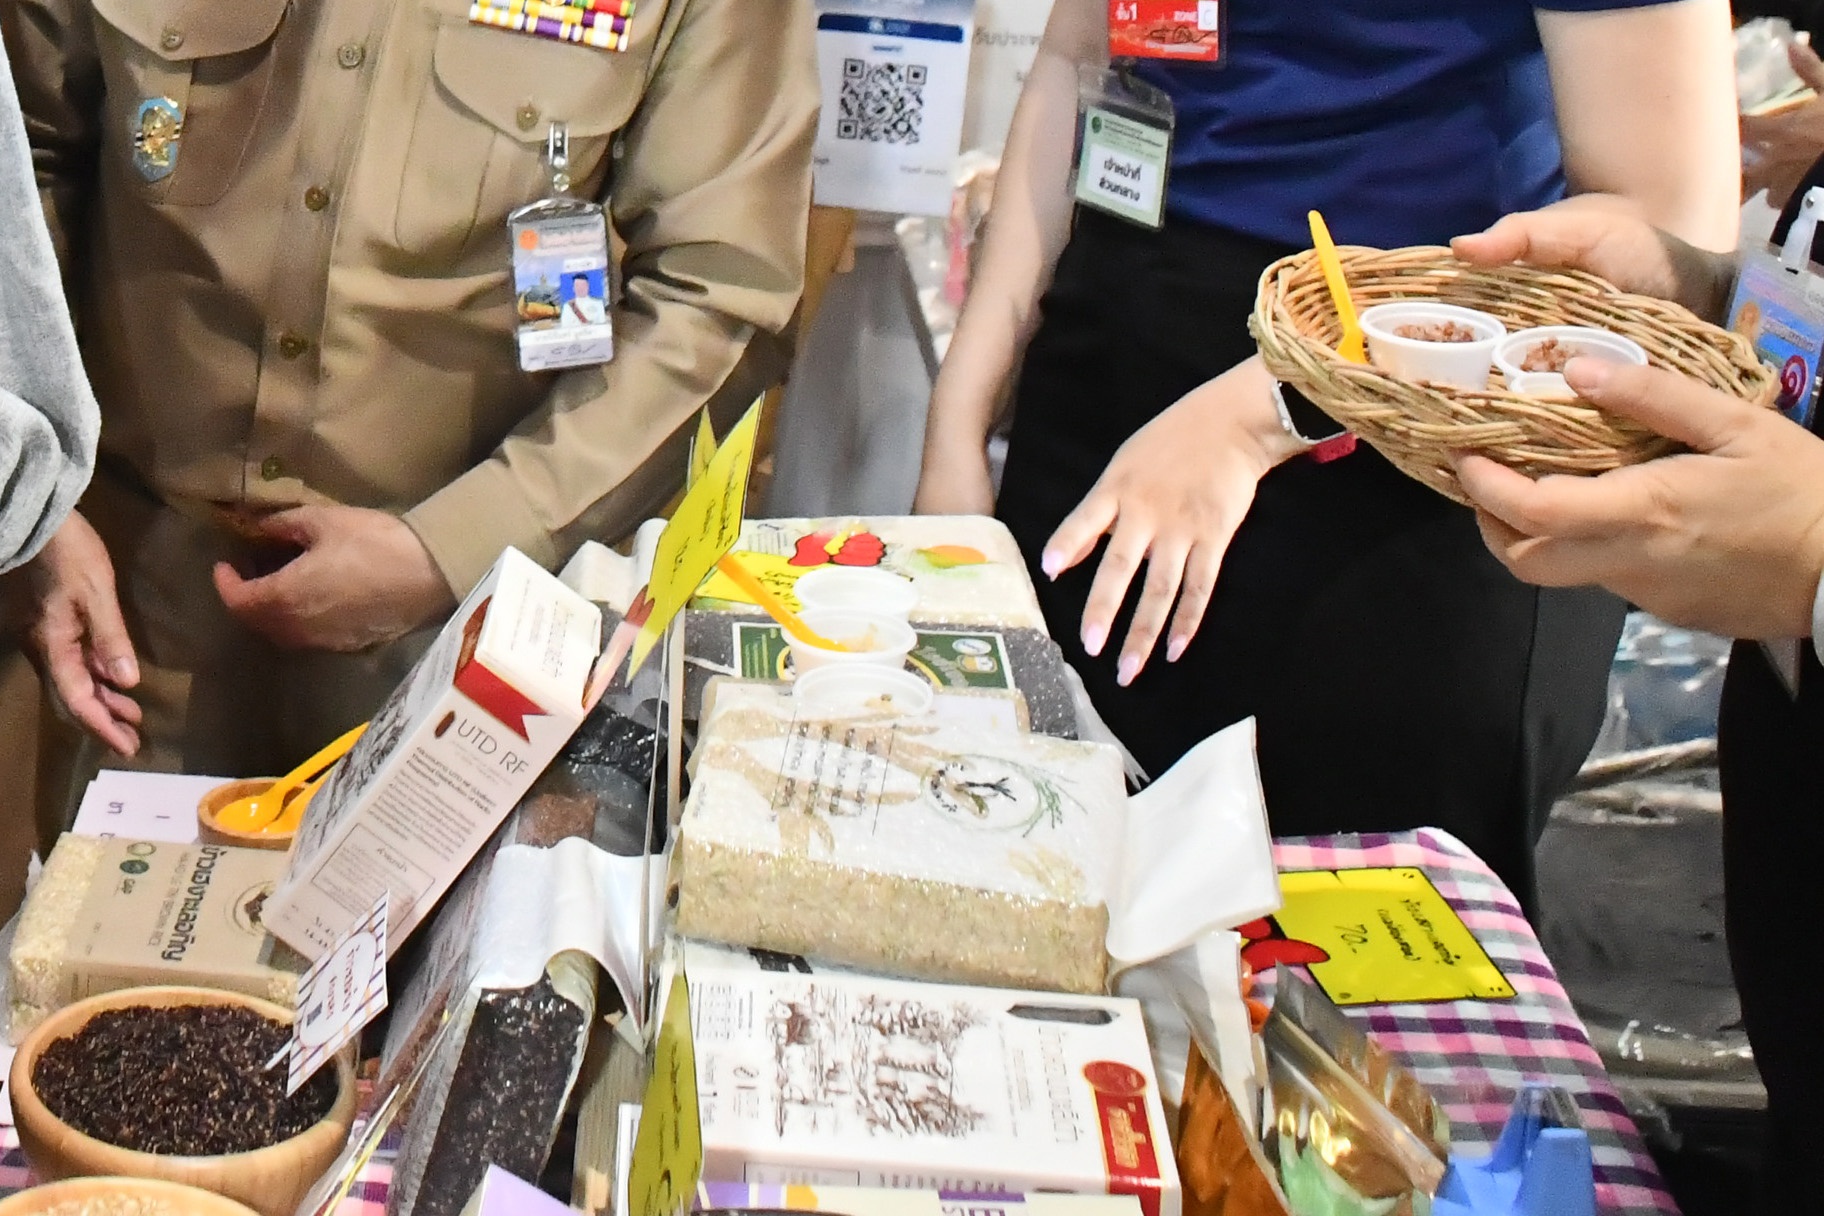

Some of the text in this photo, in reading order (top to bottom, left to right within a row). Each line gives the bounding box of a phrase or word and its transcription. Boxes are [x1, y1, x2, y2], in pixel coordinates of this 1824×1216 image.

[1104, 155, 1143, 181] เจ้าหน้าที่
[1099, 175, 1141, 202] ส่วนกลาง
[457, 718, 498, 755] UTD
[499, 751, 529, 774] RF
